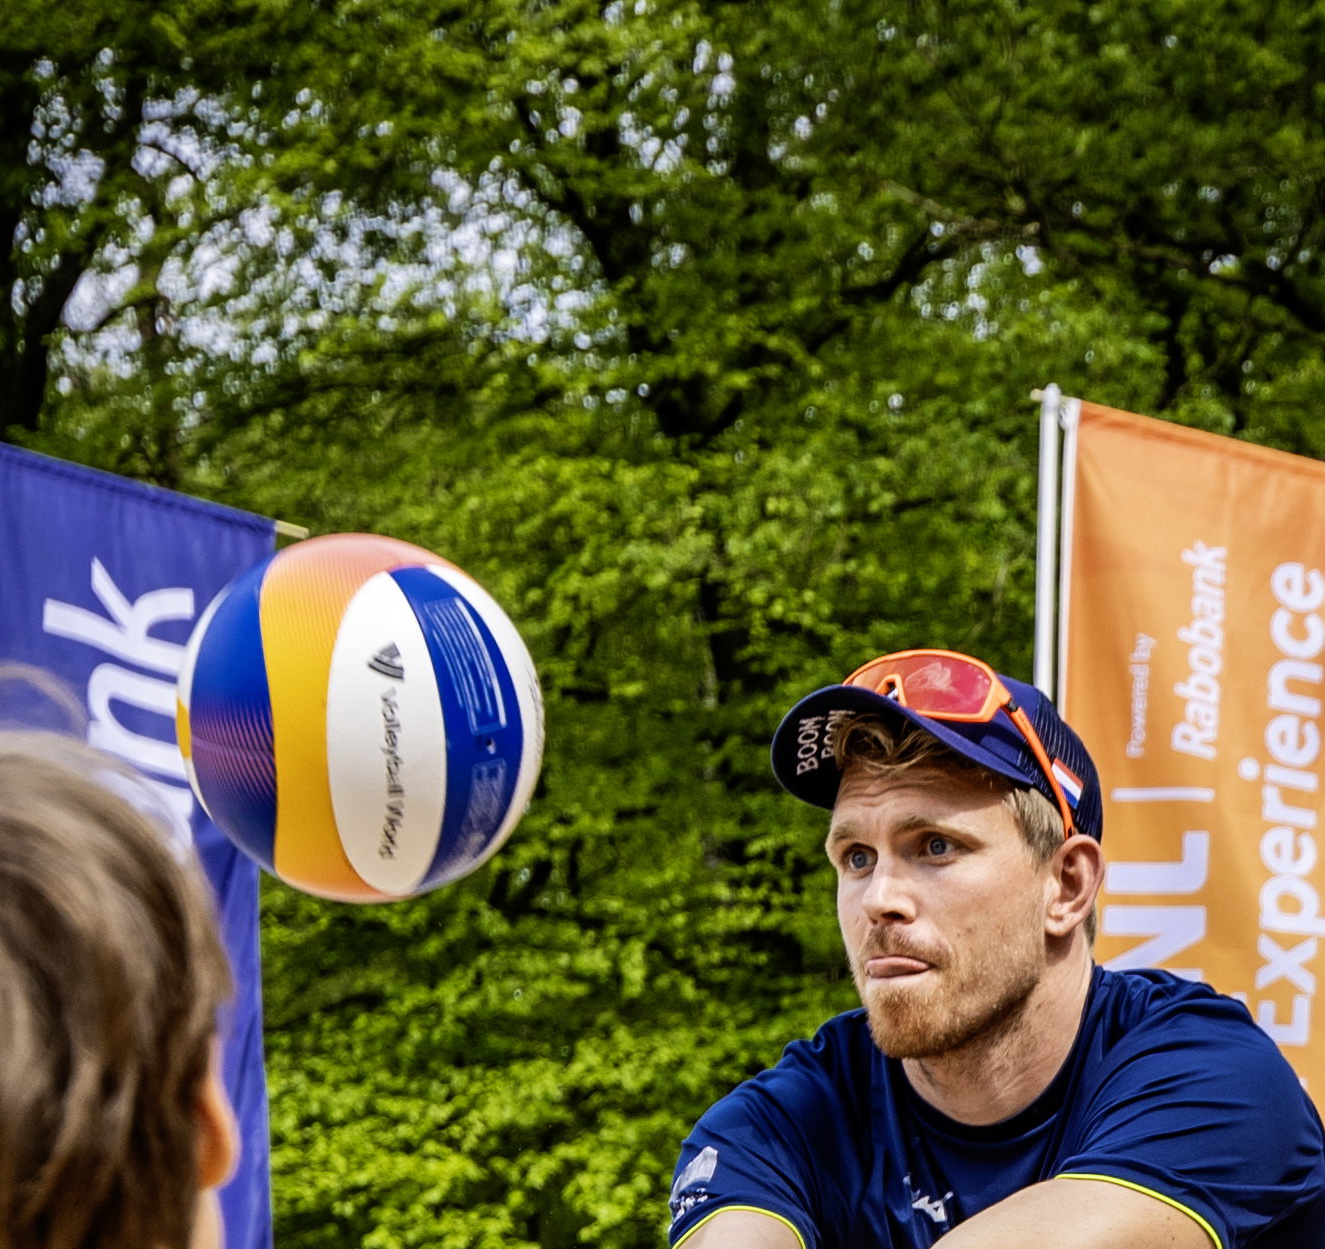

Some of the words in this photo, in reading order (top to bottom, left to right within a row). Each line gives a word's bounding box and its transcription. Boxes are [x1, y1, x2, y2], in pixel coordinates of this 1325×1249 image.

[1128, 632, 1158, 664] by
[1171, 539, 1227, 761] Rabobank
[380, 686, 405, 798] Volleyball
[796, 715, 826, 776] BOOM
[1124, 664, 1151, 760] Powered
